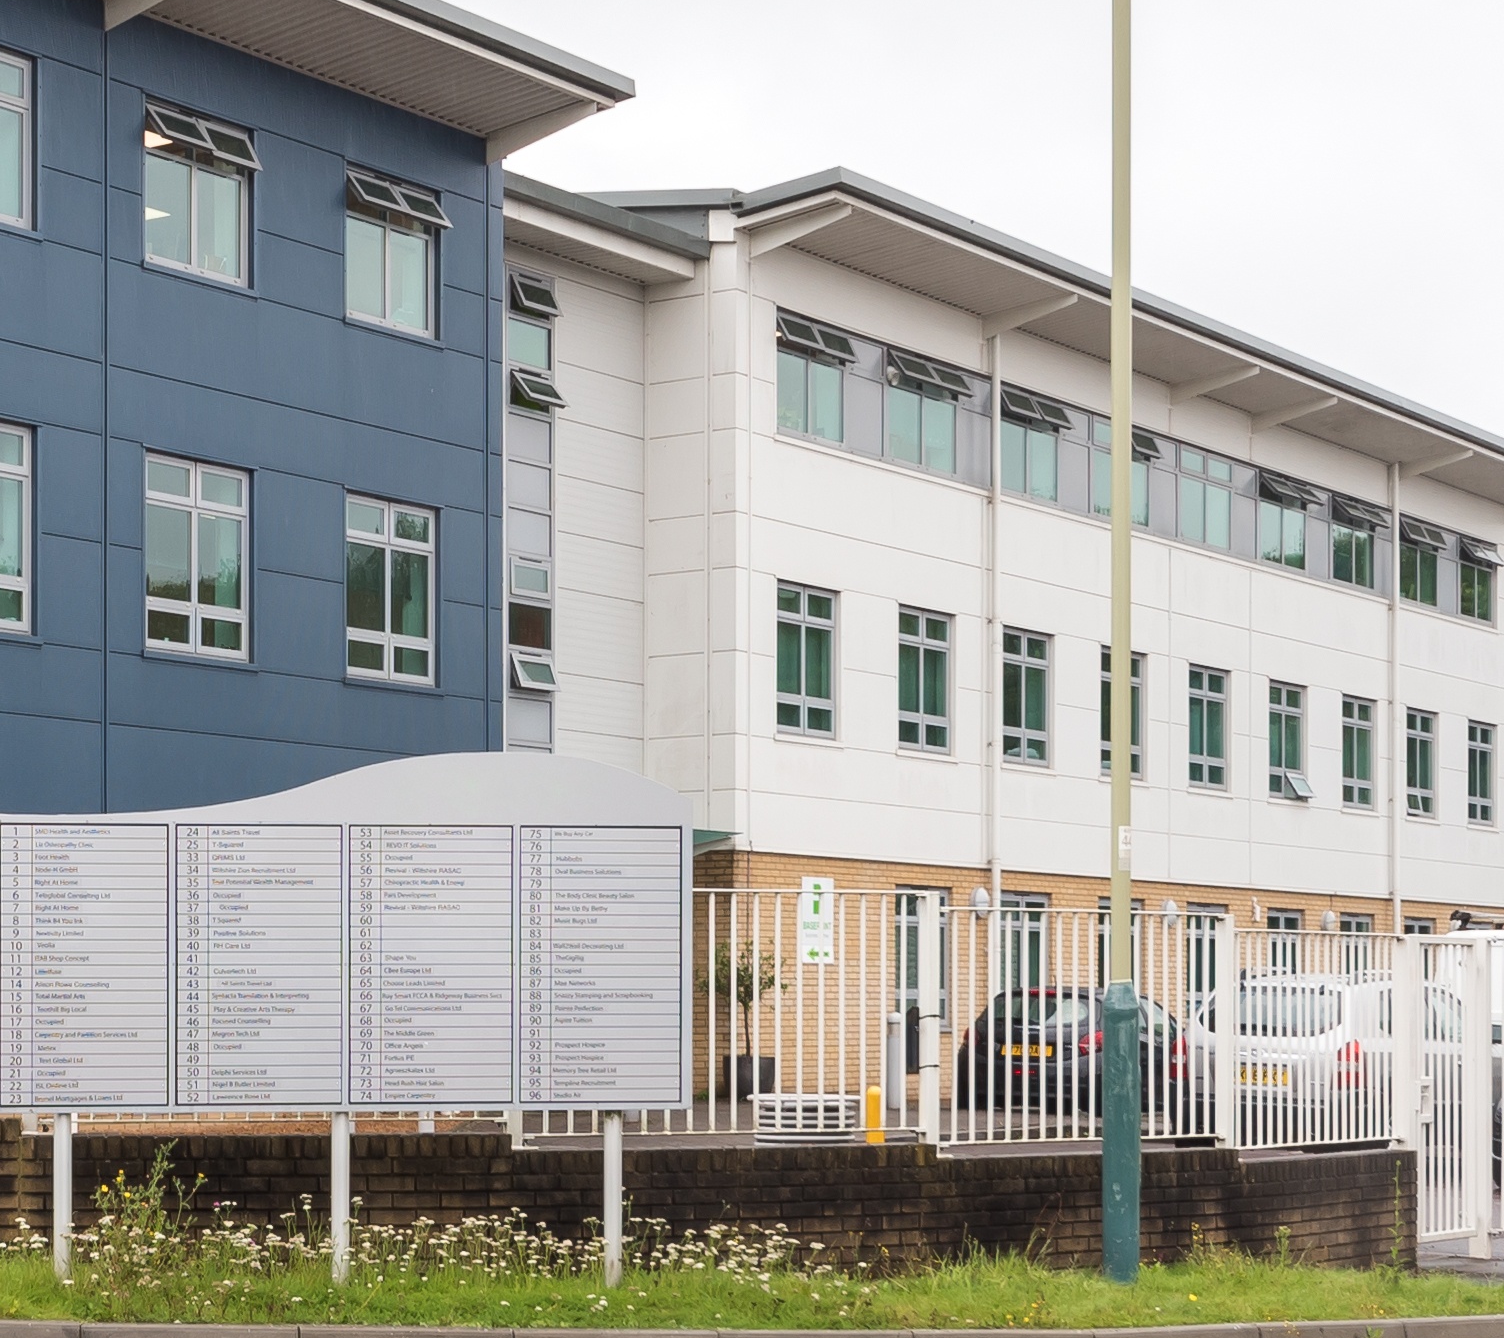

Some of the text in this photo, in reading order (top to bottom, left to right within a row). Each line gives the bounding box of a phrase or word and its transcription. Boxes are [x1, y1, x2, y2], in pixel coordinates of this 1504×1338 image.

[187, 827, 199, 837] 24
[360, 828, 372, 837] 53
[530, 830, 541, 838] 75
[13, 839, 19, 849] 2
[187, 840, 199, 849] 25
[360, 840, 372, 850] 54
[530, 842, 542, 851] 76
[13, 852, 19, 862] 3
[187, 852, 199, 862] 33
[360, 853, 414, 862] 55 Occupied
[530, 854, 541, 863] 77
[13, 865, 19, 874] 4
[187, 865, 199, 875] 34
[360, 865, 372, 875] 56
[530, 867, 542, 876] 78
[13, 877, 19, 887] 5
[33, 879, 51, 887] Right
[187, 878, 199, 887] 35
[360, 878, 372, 888] 57
[530, 879, 542, 888] 79
[12, 890, 19, 900] 6
[187, 890, 242, 900] 36 Occupied
[360, 891, 372, 900] 58
[530, 891, 542, 900] 80
[13, 903, 19, 912] 7
[34, 904, 52, 913] Right
[187, 903, 249, 912] 37 Occupied
[360, 903, 372, 912] 59
[530, 904, 540, 913] 81
[13, 916, 19, 925] 8
[188, 916, 199, 925] 38
[360, 916, 372, 925] 60
[530, 916, 541, 925] 82
[13, 928, 19, 938] 9
[188, 928, 199, 937] 39
[360, 928, 371, 937] 61
[529, 929, 541, 938] 83
[11, 941, 22, 951] 10
[187, 941, 199, 951] 40
[360, 941, 372, 950] 62
[529, 941, 541, 951] 84
[11, 954, 20, 963] 11
[187, 954, 198, 963] 41
[360, 953, 372, 962] 63
[530, 954, 541, 963] 85
[11, 966, 22, 976] 12
[187, 966, 199, 976] 42
[360, 966, 372, 975] 64
[529, 966, 583, 975] 86 Occupied
[11, 980, 22, 989] 14
[186, 979, 199, 988] 43
[360, 978, 372, 987] 65
[529, 979, 541, 988] 87
[11, 992, 22, 1002] 15
[187, 992, 199, 1001] 44
[360, 991, 373, 1000] 66
[529, 991, 542, 1000] 88
[11, 1005, 22, 1014] 16
[187, 1004, 199, 1014] 45
[360, 1004, 372, 1013] 67
[529, 1003, 542, 1012] 89
[11, 1018, 65, 1027] 17 Occupied
[186, 1017, 199, 1026] 46
[360, 1016, 413, 1025] 68 Occupied
[529, 1016, 542, 1025] 90
[11, 1030, 22, 1040] 18
[187, 1029, 199, 1038] 47
[360, 1029, 372, 1038] 69
[529, 1029, 540, 1038] 91
[11, 1043, 22, 1053] 19
[187, 1042, 243, 1052] 48 Occupied
[361, 1041, 372, 1050] 70
[529, 1041, 541, 1050] 92
[10, 1056, 22, 1065] 20
[187, 1055, 199, 1064] 49
[360, 1054, 371, 1063] 71
[529, 1053, 541, 1063] 93
[10, 1069, 20, 1078] 21
[187, 1067, 199, 1077] 50
[361, 1066, 372, 1075] 72
[529, 1066, 541, 1075] 94
[10, 1081, 22, 1091] 22
[187, 1080, 198, 1090] 51
[360, 1079, 372, 1088] 73
[529, 1078, 541, 1087] 95
[10, 1094, 22, 1104] 23
[187, 1093, 199, 1102] 52
[360, 1091, 372, 1100] 74
[529, 1091, 542, 1100] 96
